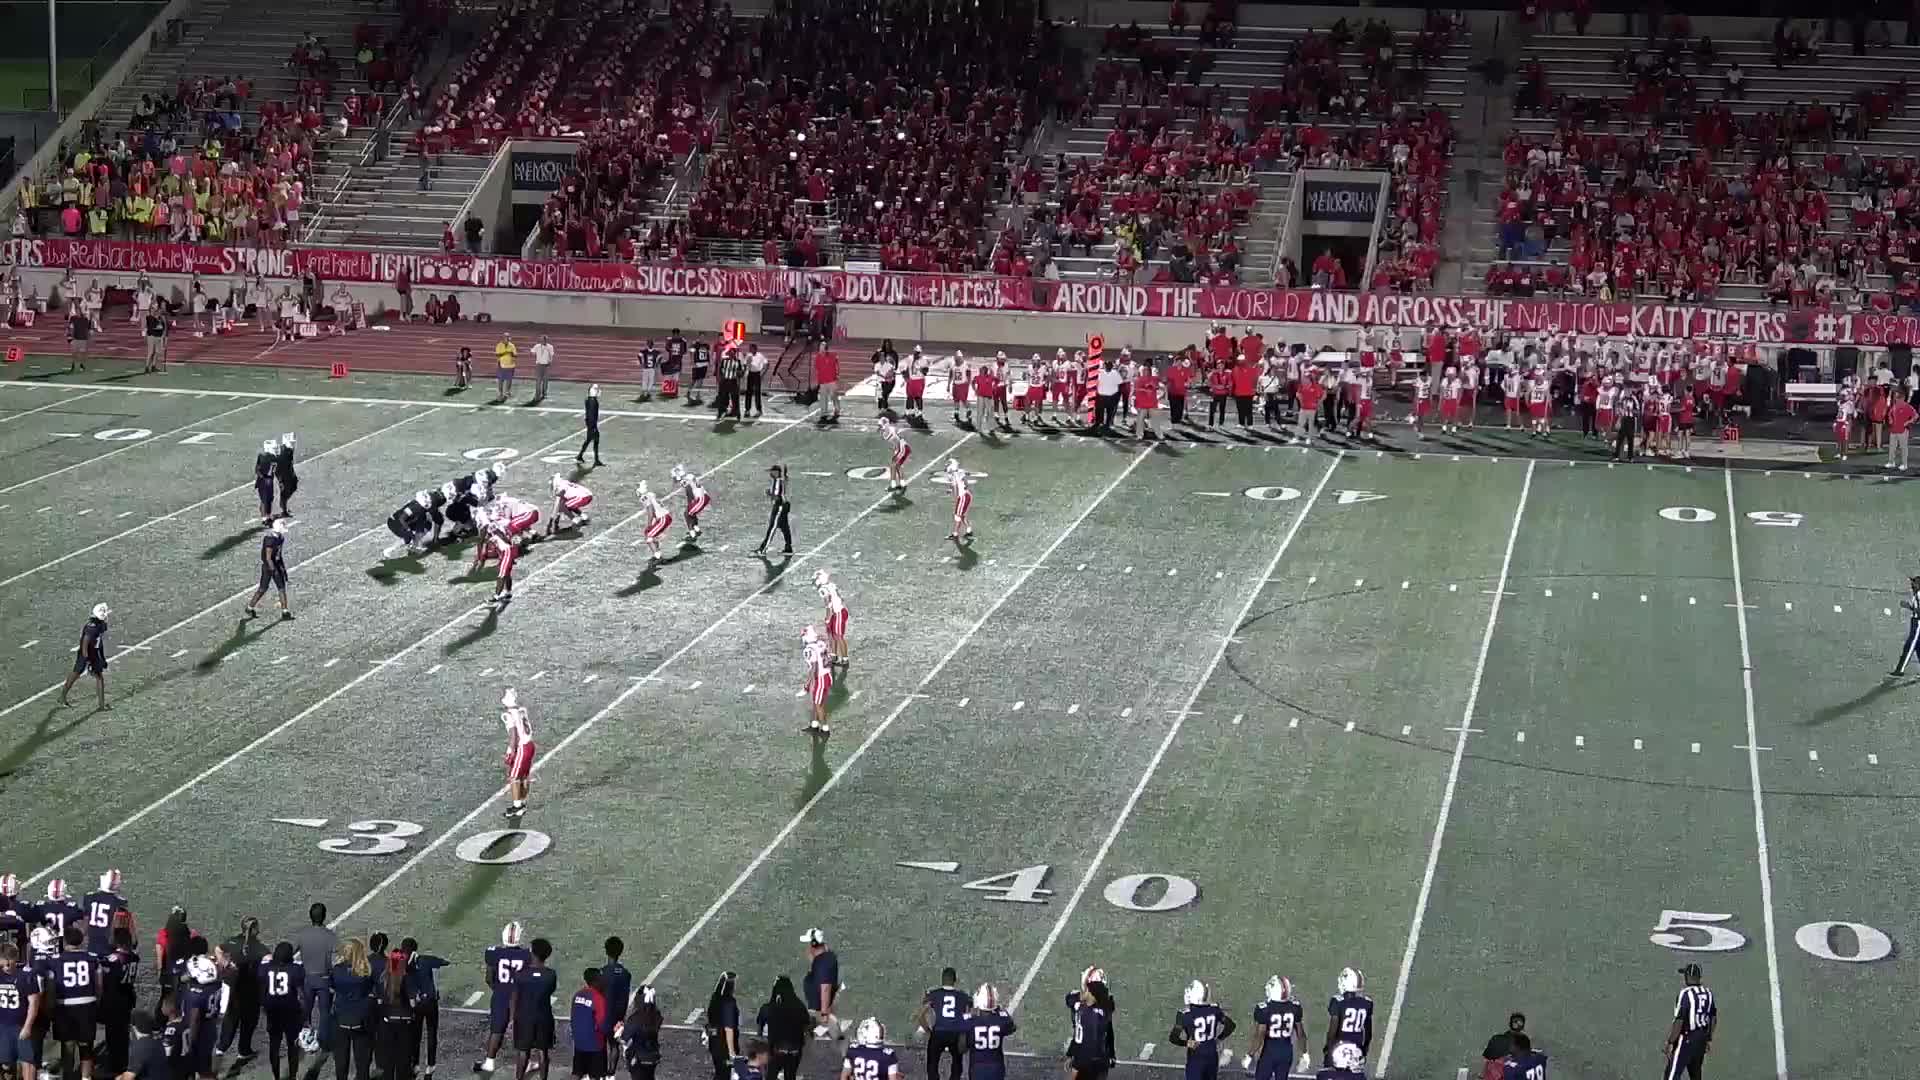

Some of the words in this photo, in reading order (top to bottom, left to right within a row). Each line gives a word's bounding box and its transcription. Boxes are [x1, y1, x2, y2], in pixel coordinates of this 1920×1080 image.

[0, 239, 44, 266] GERS
[221, 248, 293, 277] STRONG
[846, 273, 903, 304] DOWN
[1053, 283, 1148, 316] AROUND
[1155, 286, 1203, 318] THE
[1210, 290, 1300, 321] WORLD
[1308, 291, 1359, 322] AND
[1365, 291, 1464, 327] ACROSS
[1466, 298, 1512, 331] THE
[1516, 302, 1615, 334] NATION
[1630, 305, 1697, 339] KATY
[1700, 307, 1789, 342] TIGERS
[1813, 312, 1855, 344] #1
[89, 901, 111, 928] 15
[63, 960, 90, 988] 58
[268, 970, 289, 996] 13
[942, 995, 956, 1018] 2
[1194, 1015, 1216, 1042] 27
[1269, 1012, 1294, 1038] 23
[1342, 1007, 1367, 1033] 20
[974, 1025, 1001, 1050] 56
[853, 1056, 879, 1080] 22
